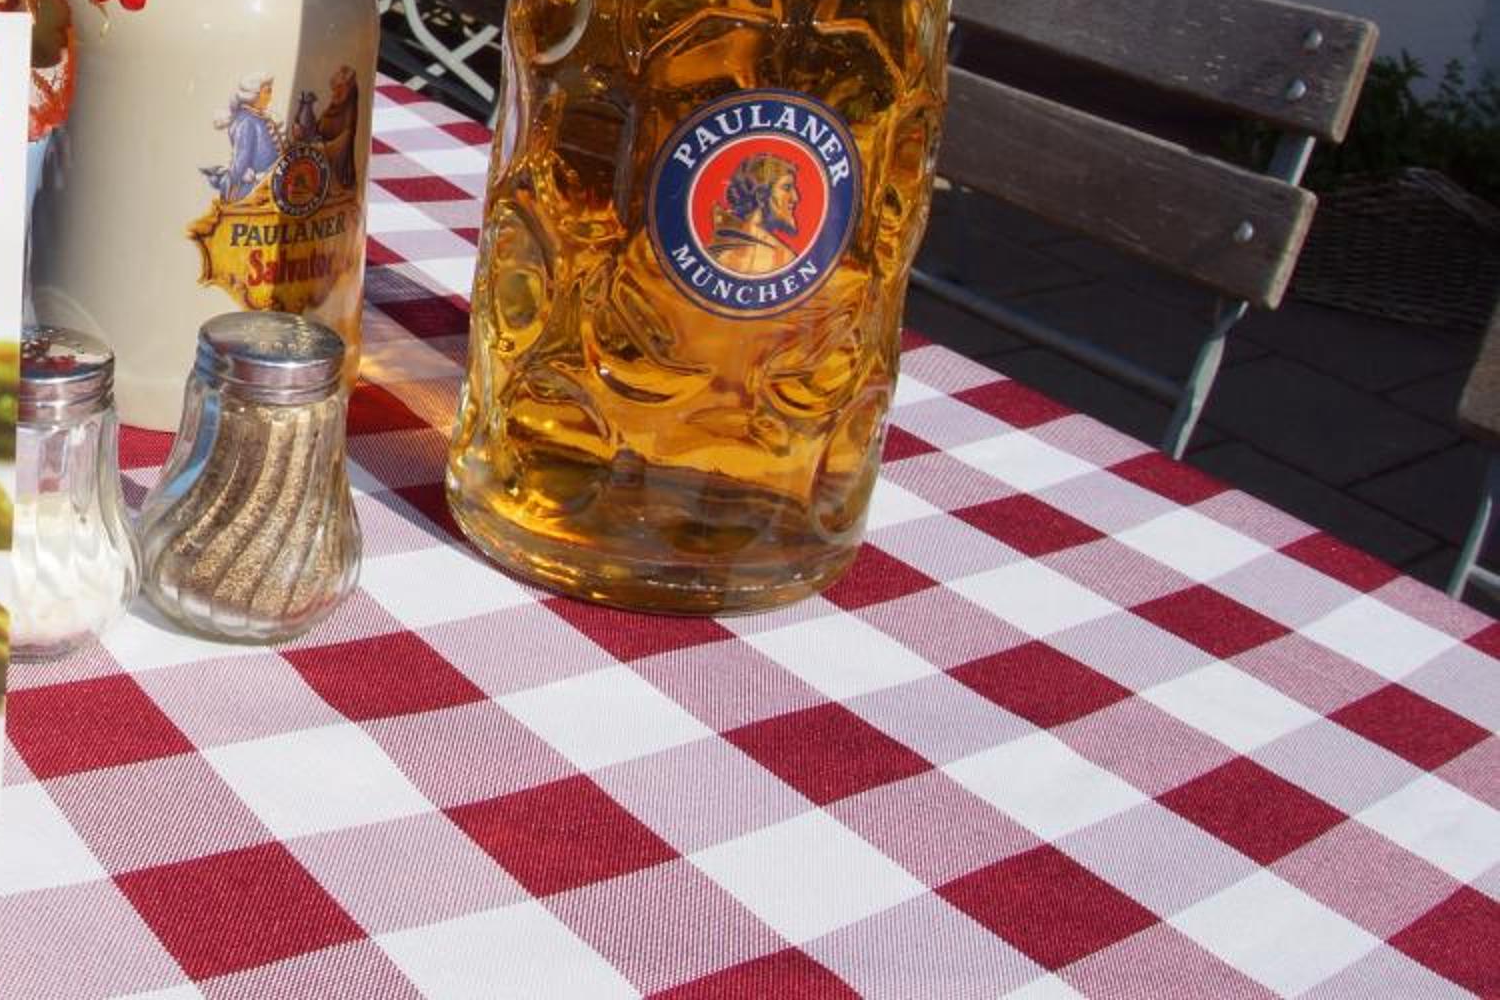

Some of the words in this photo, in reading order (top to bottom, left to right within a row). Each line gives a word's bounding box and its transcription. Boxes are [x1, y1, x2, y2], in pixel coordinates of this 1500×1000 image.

[672, 104, 851, 188] PAULANER
[230, 213, 346, 247] PAULANER
[671, 244, 819, 305] MÜNCHEN
